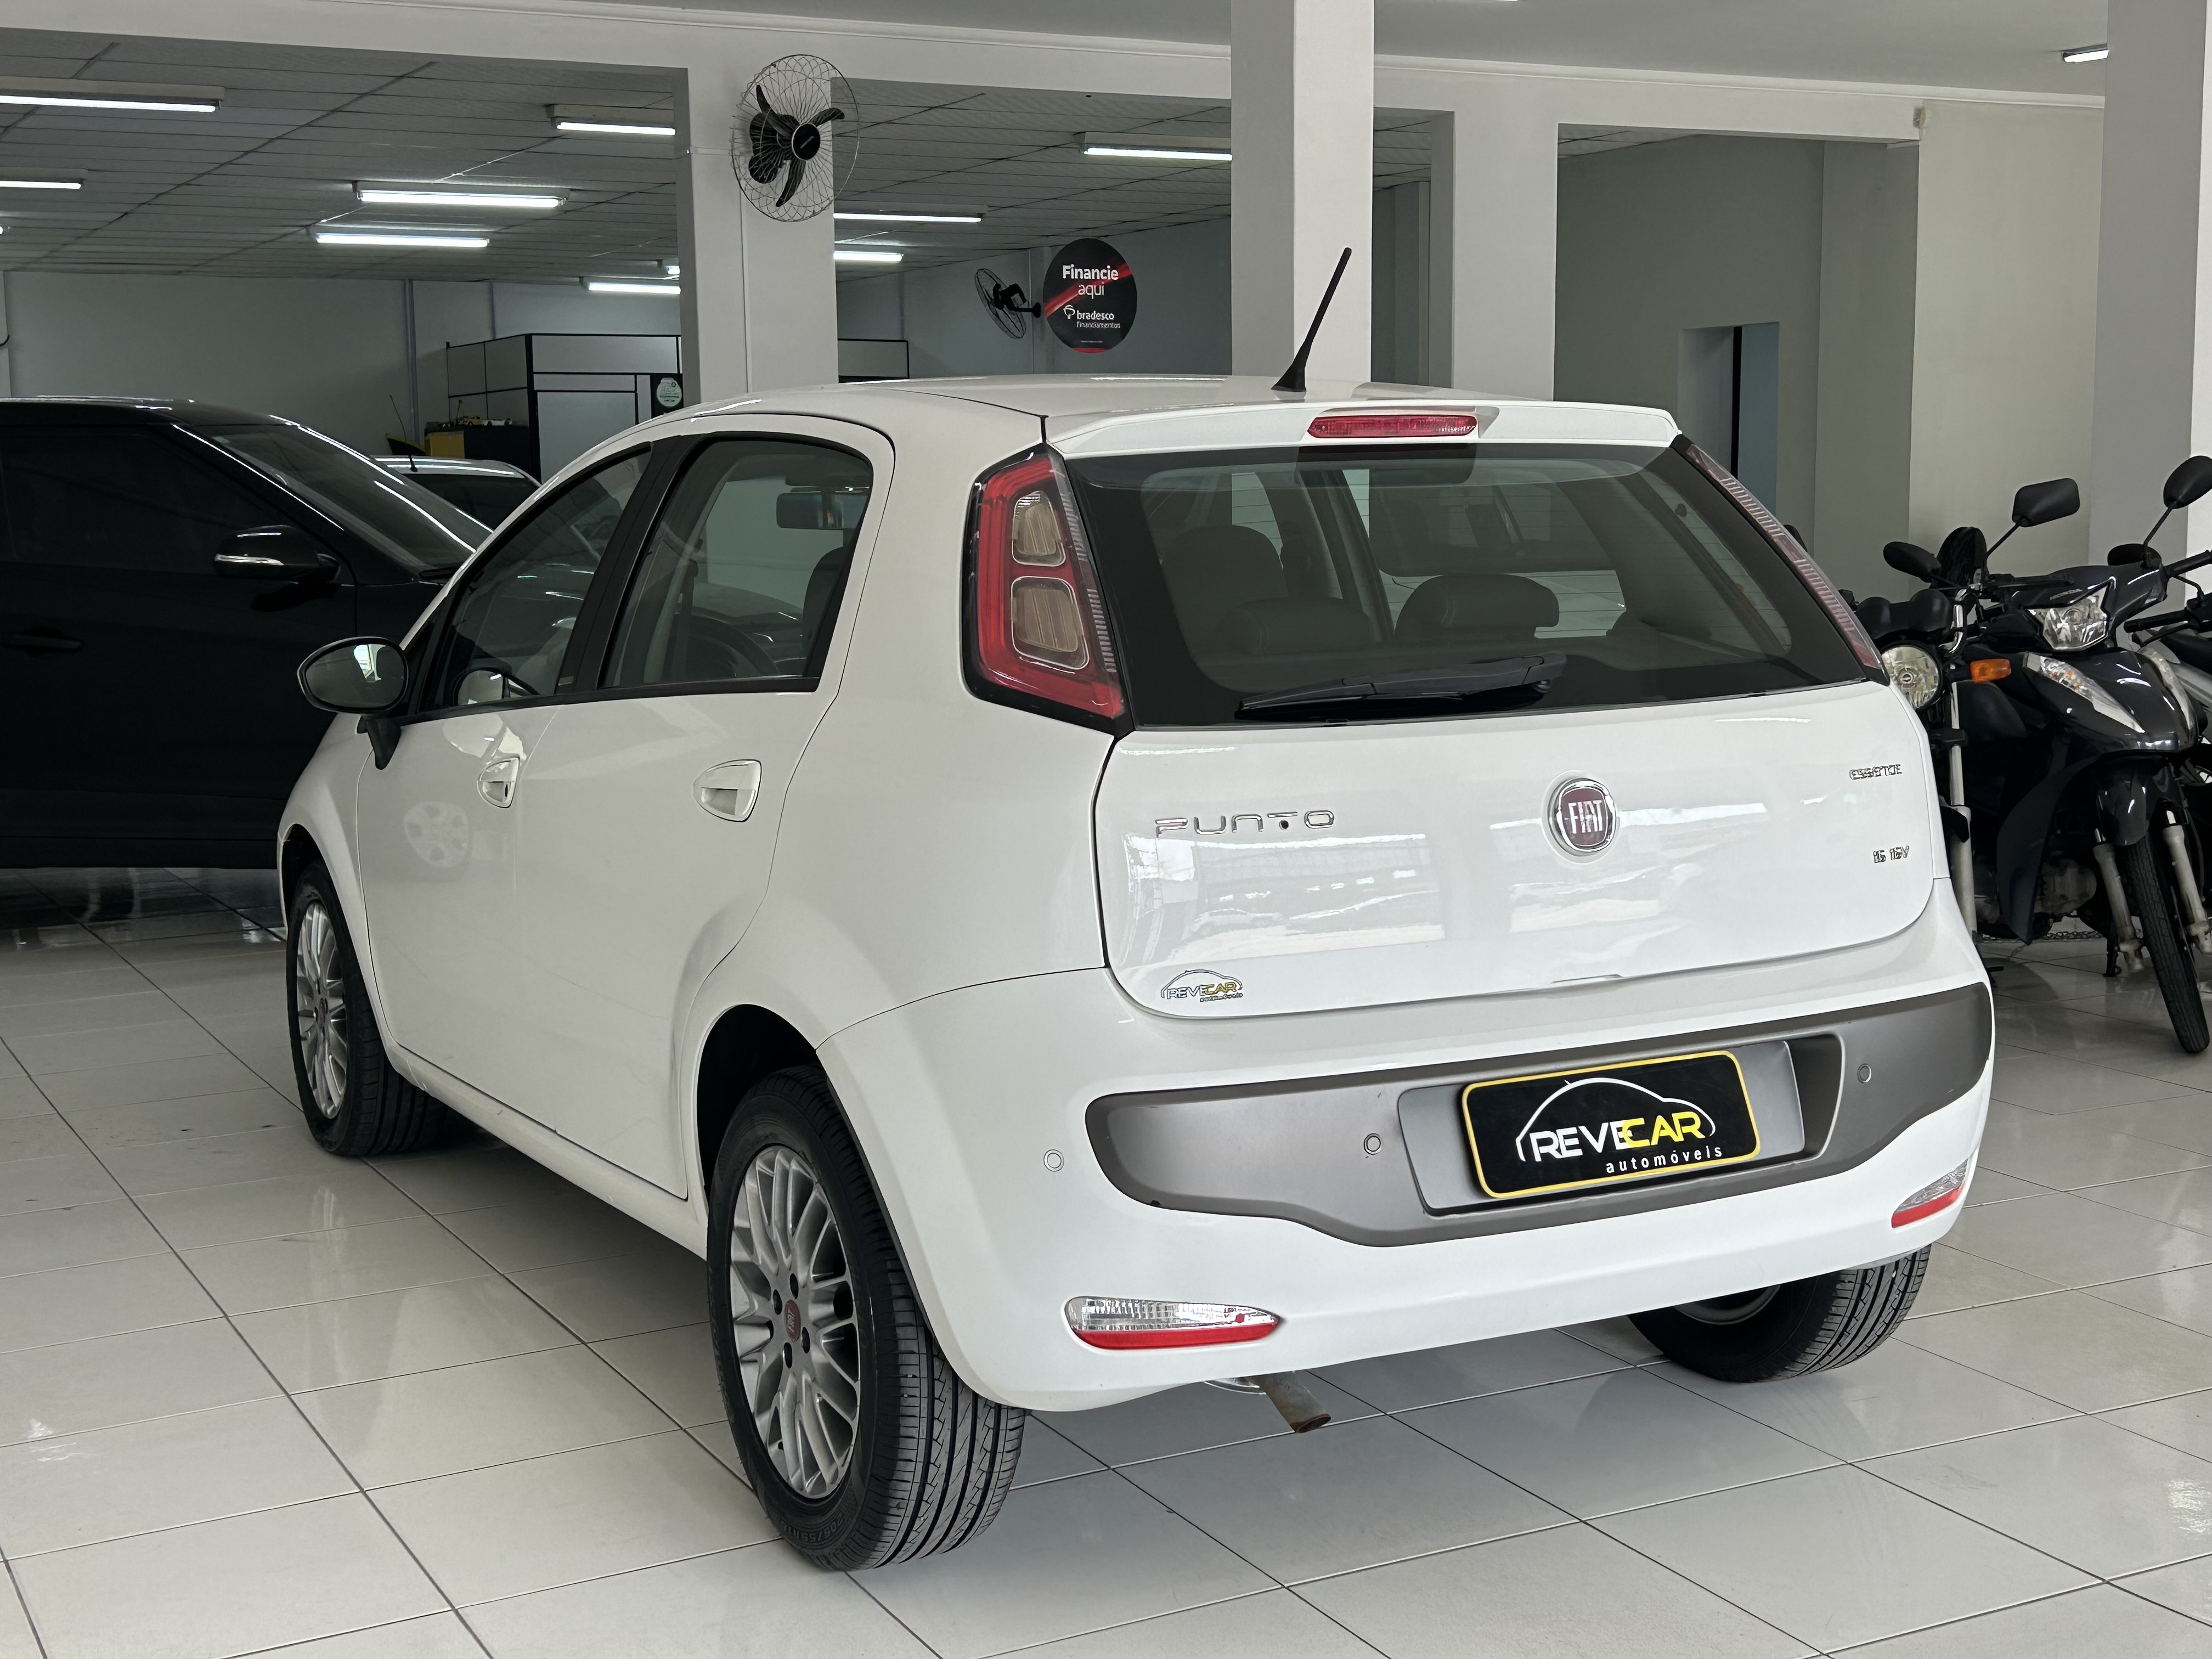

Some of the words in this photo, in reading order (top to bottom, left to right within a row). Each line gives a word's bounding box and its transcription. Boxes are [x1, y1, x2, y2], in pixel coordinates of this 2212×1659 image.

[1062, 264, 1119, 280] Financie
[1077, 281, 1104, 299] aqui
[1076, 309, 1115, 320] bradesco
[1155, 810, 1335, 838] PUNTO
[1568, 799, 1603, 834] FIAT
[1166, 981, 1237, 1000] REVECAR
[1529, 1111, 1706, 1162] REVECAR
[1605, 1145, 1722, 1173] automóveis
